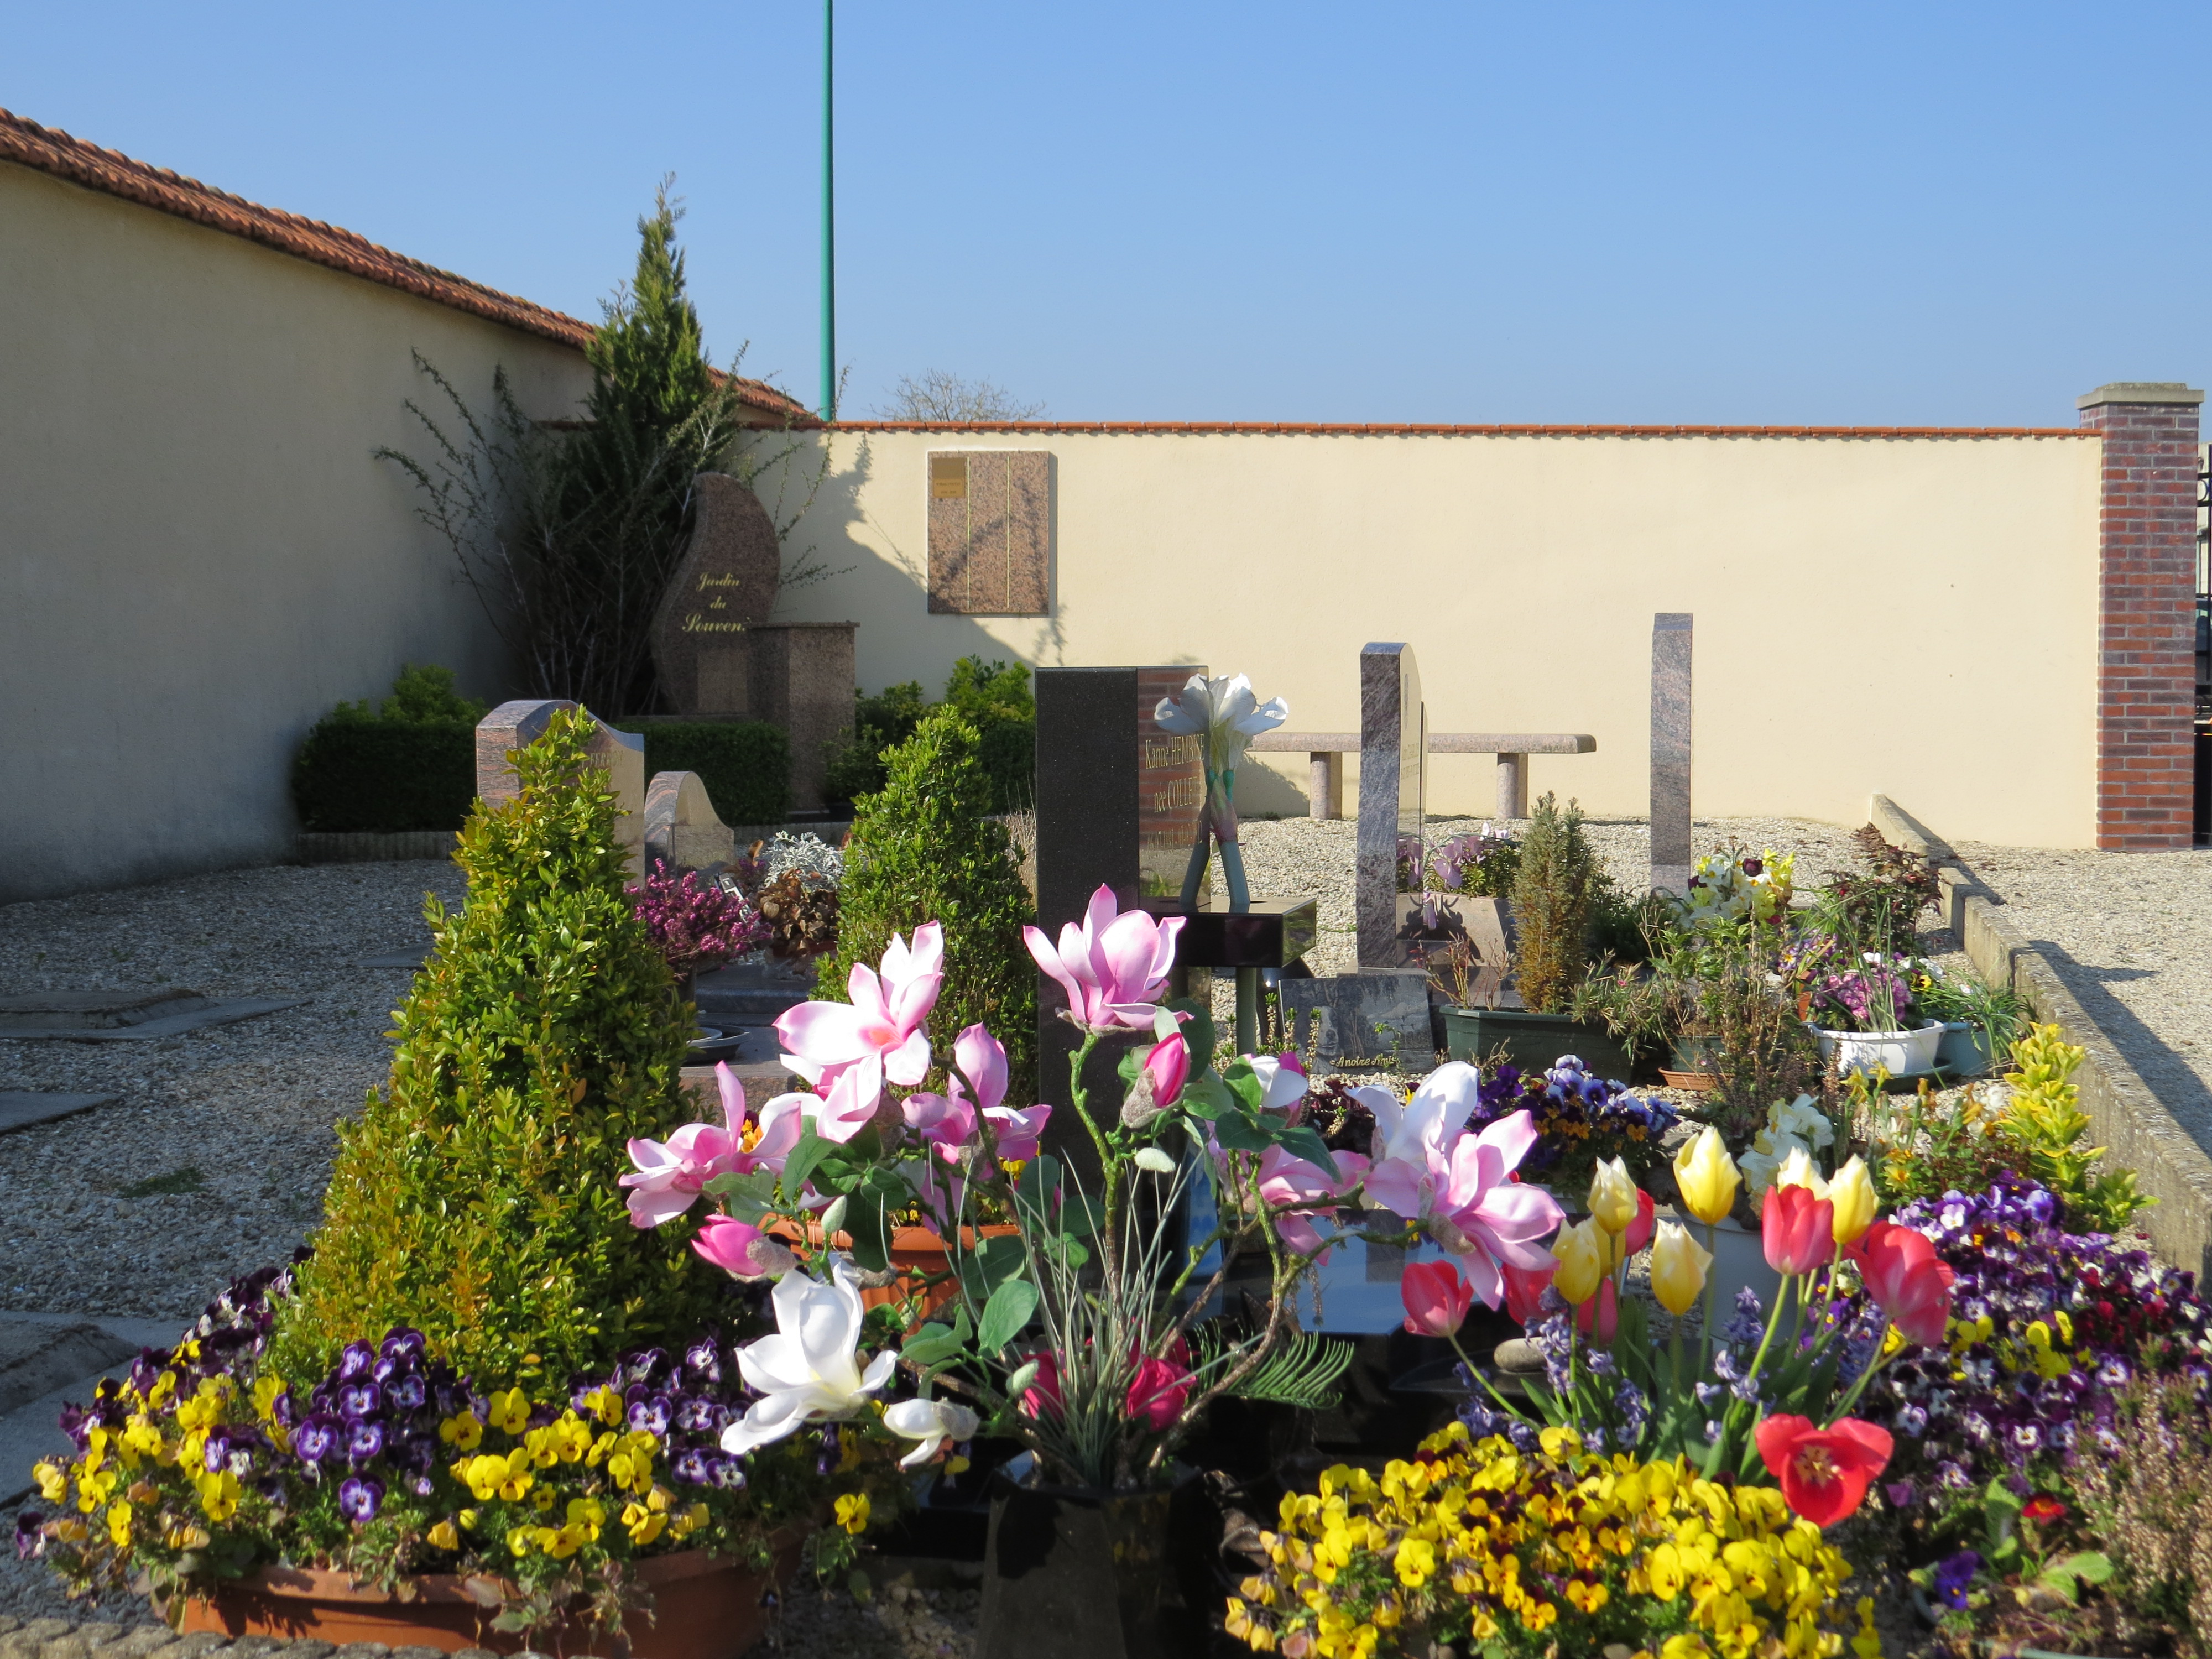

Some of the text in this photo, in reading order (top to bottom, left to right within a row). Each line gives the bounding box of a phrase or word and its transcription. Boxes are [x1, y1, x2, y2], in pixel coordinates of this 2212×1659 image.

[696, 571, 739, 591] Jardin
[710, 596, 727, 609] du
[1145, 738, 1169, 769] Karine
